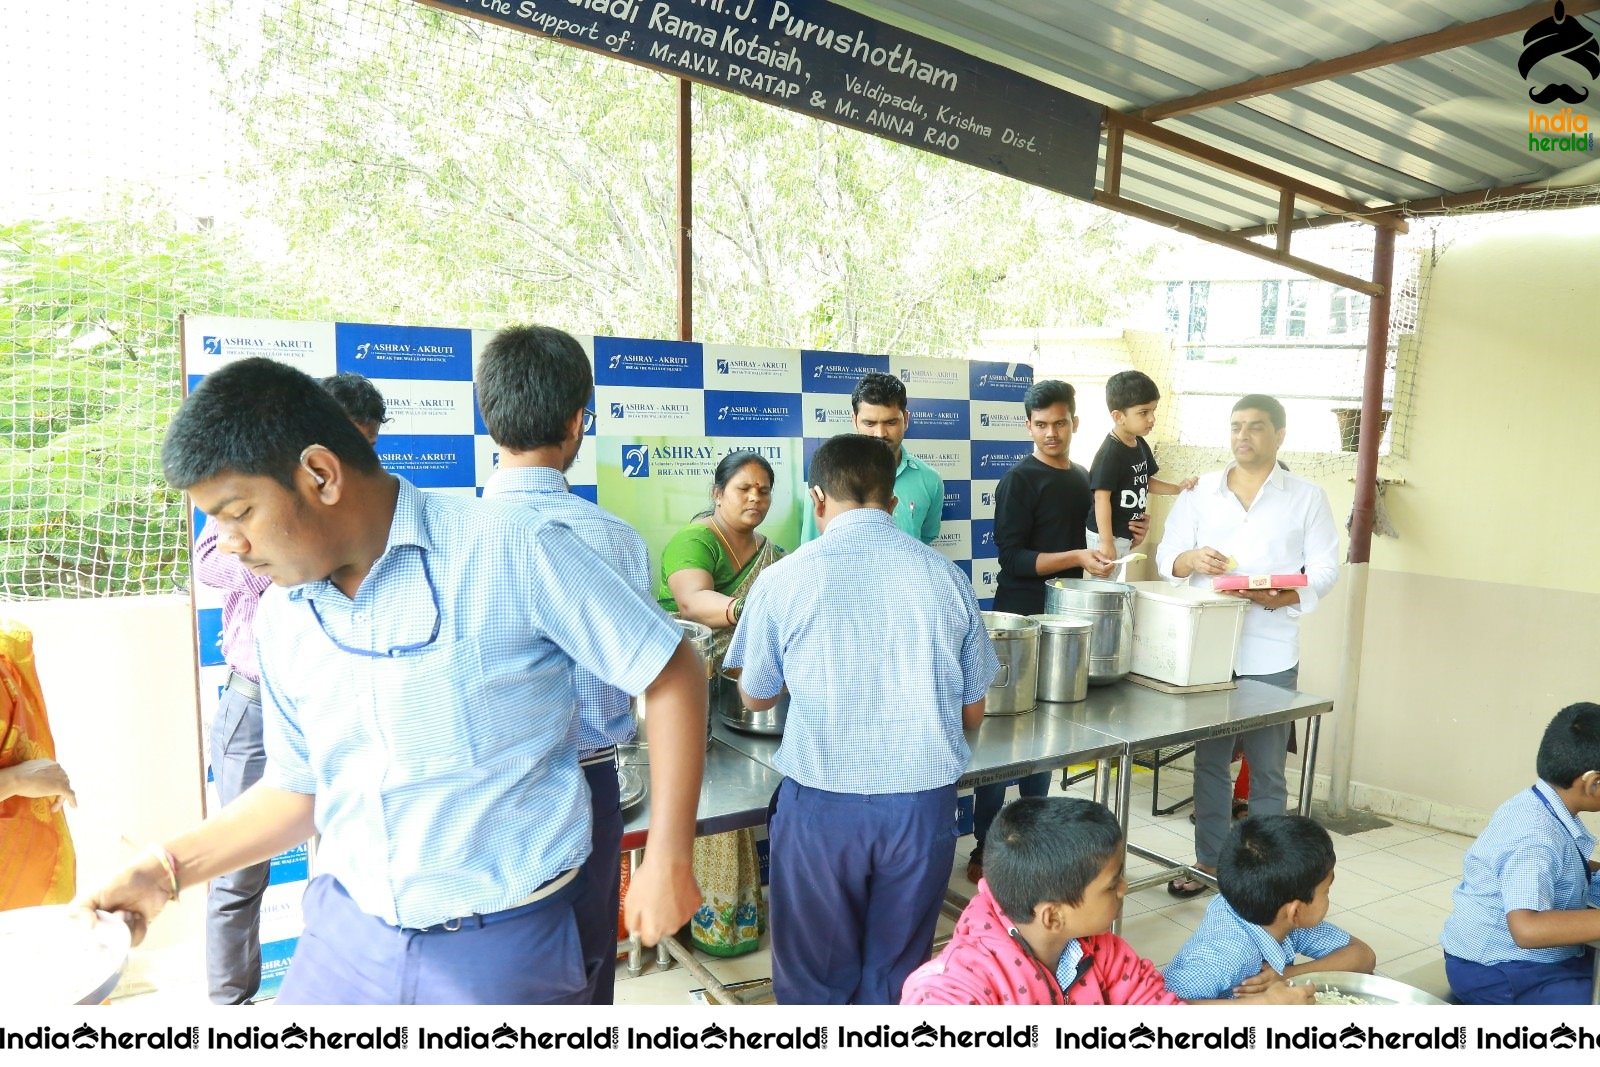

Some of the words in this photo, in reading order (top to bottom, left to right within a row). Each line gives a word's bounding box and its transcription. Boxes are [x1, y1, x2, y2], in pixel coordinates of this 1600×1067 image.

[735, 0, 758, 24] J.
[768, 0, 958, 92] Purushotham
[516, 1, 599, 40] Support
[727, 64, 800, 99] PRATAP
[809, 90, 827, 110] &
[834, 98, 860, 120] Mr.
[866, 109, 914, 137] ANNA
[924, 127, 960, 151] RAO
[648, 2, 717, 48] Rama
[720, 25, 811, 85] Kotaiah,
[845, 74, 929, 121] Veldipadu,
[936, 105, 992, 138] Krishna
[1001, 128, 1043, 156] Dist.
[224, 338, 264, 346] ASHRAY
[273, 339, 313, 349] AKRUTI
[372, 343, 411, 352] ASHRAY
[417, 345, 453, 354] AKRUTI
[623, 355, 653, 363] ASHRAY
[659, 356, 687, 365] AKRUTI
[730, 360, 756, 368] ASHRAY
[825, 365, 850, 373] ASHRAY
[419, 399, 454, 407] AKRUTI
[660, 404, 689, 412] AKRUTI
[420, 453, 456, 461] AKRUTI
[652, 446, 714, 459] ASHRAY
[657, 468, 684, 476] BREAK
[686, 468, 701, 476] THE
